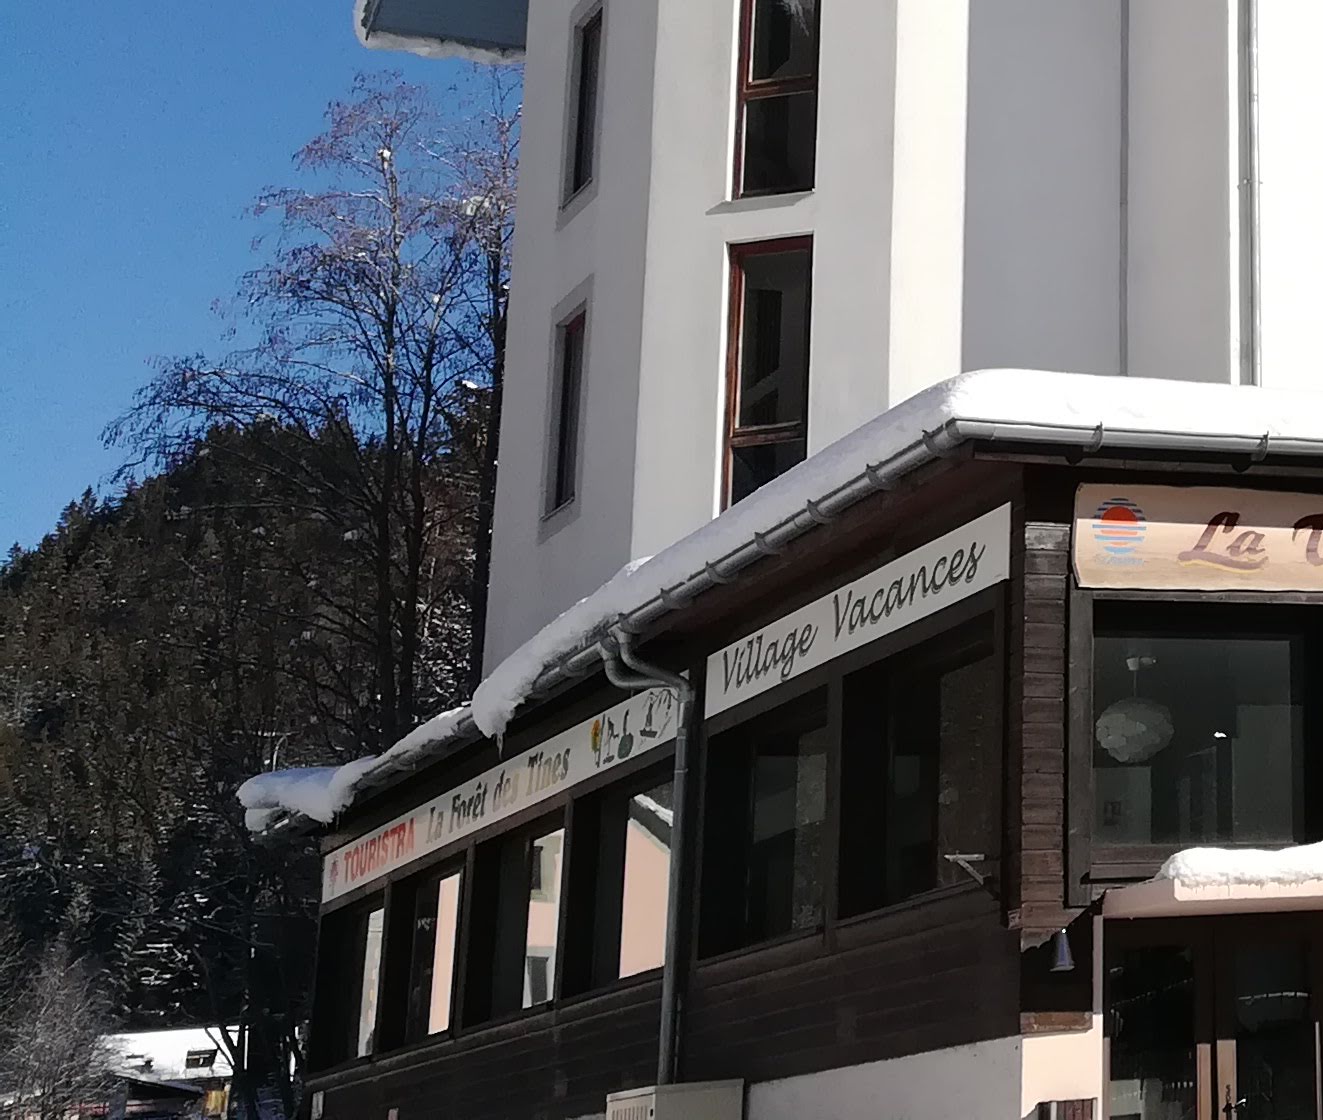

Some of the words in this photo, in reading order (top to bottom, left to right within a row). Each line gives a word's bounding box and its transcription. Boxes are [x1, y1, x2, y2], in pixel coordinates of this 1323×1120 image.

[1178, 511, 1269, 571] La
[720, 623, 818, 694] Village
[833, 541, 986, 641] Vacances
[343, 818, 416, 883] TOURISTRA
[425, 806, 444, 844] La
[450, 782, 488, 831] Forêt
[492, 769, 519, 812] des
[526, 748, 571, 796] Tines
